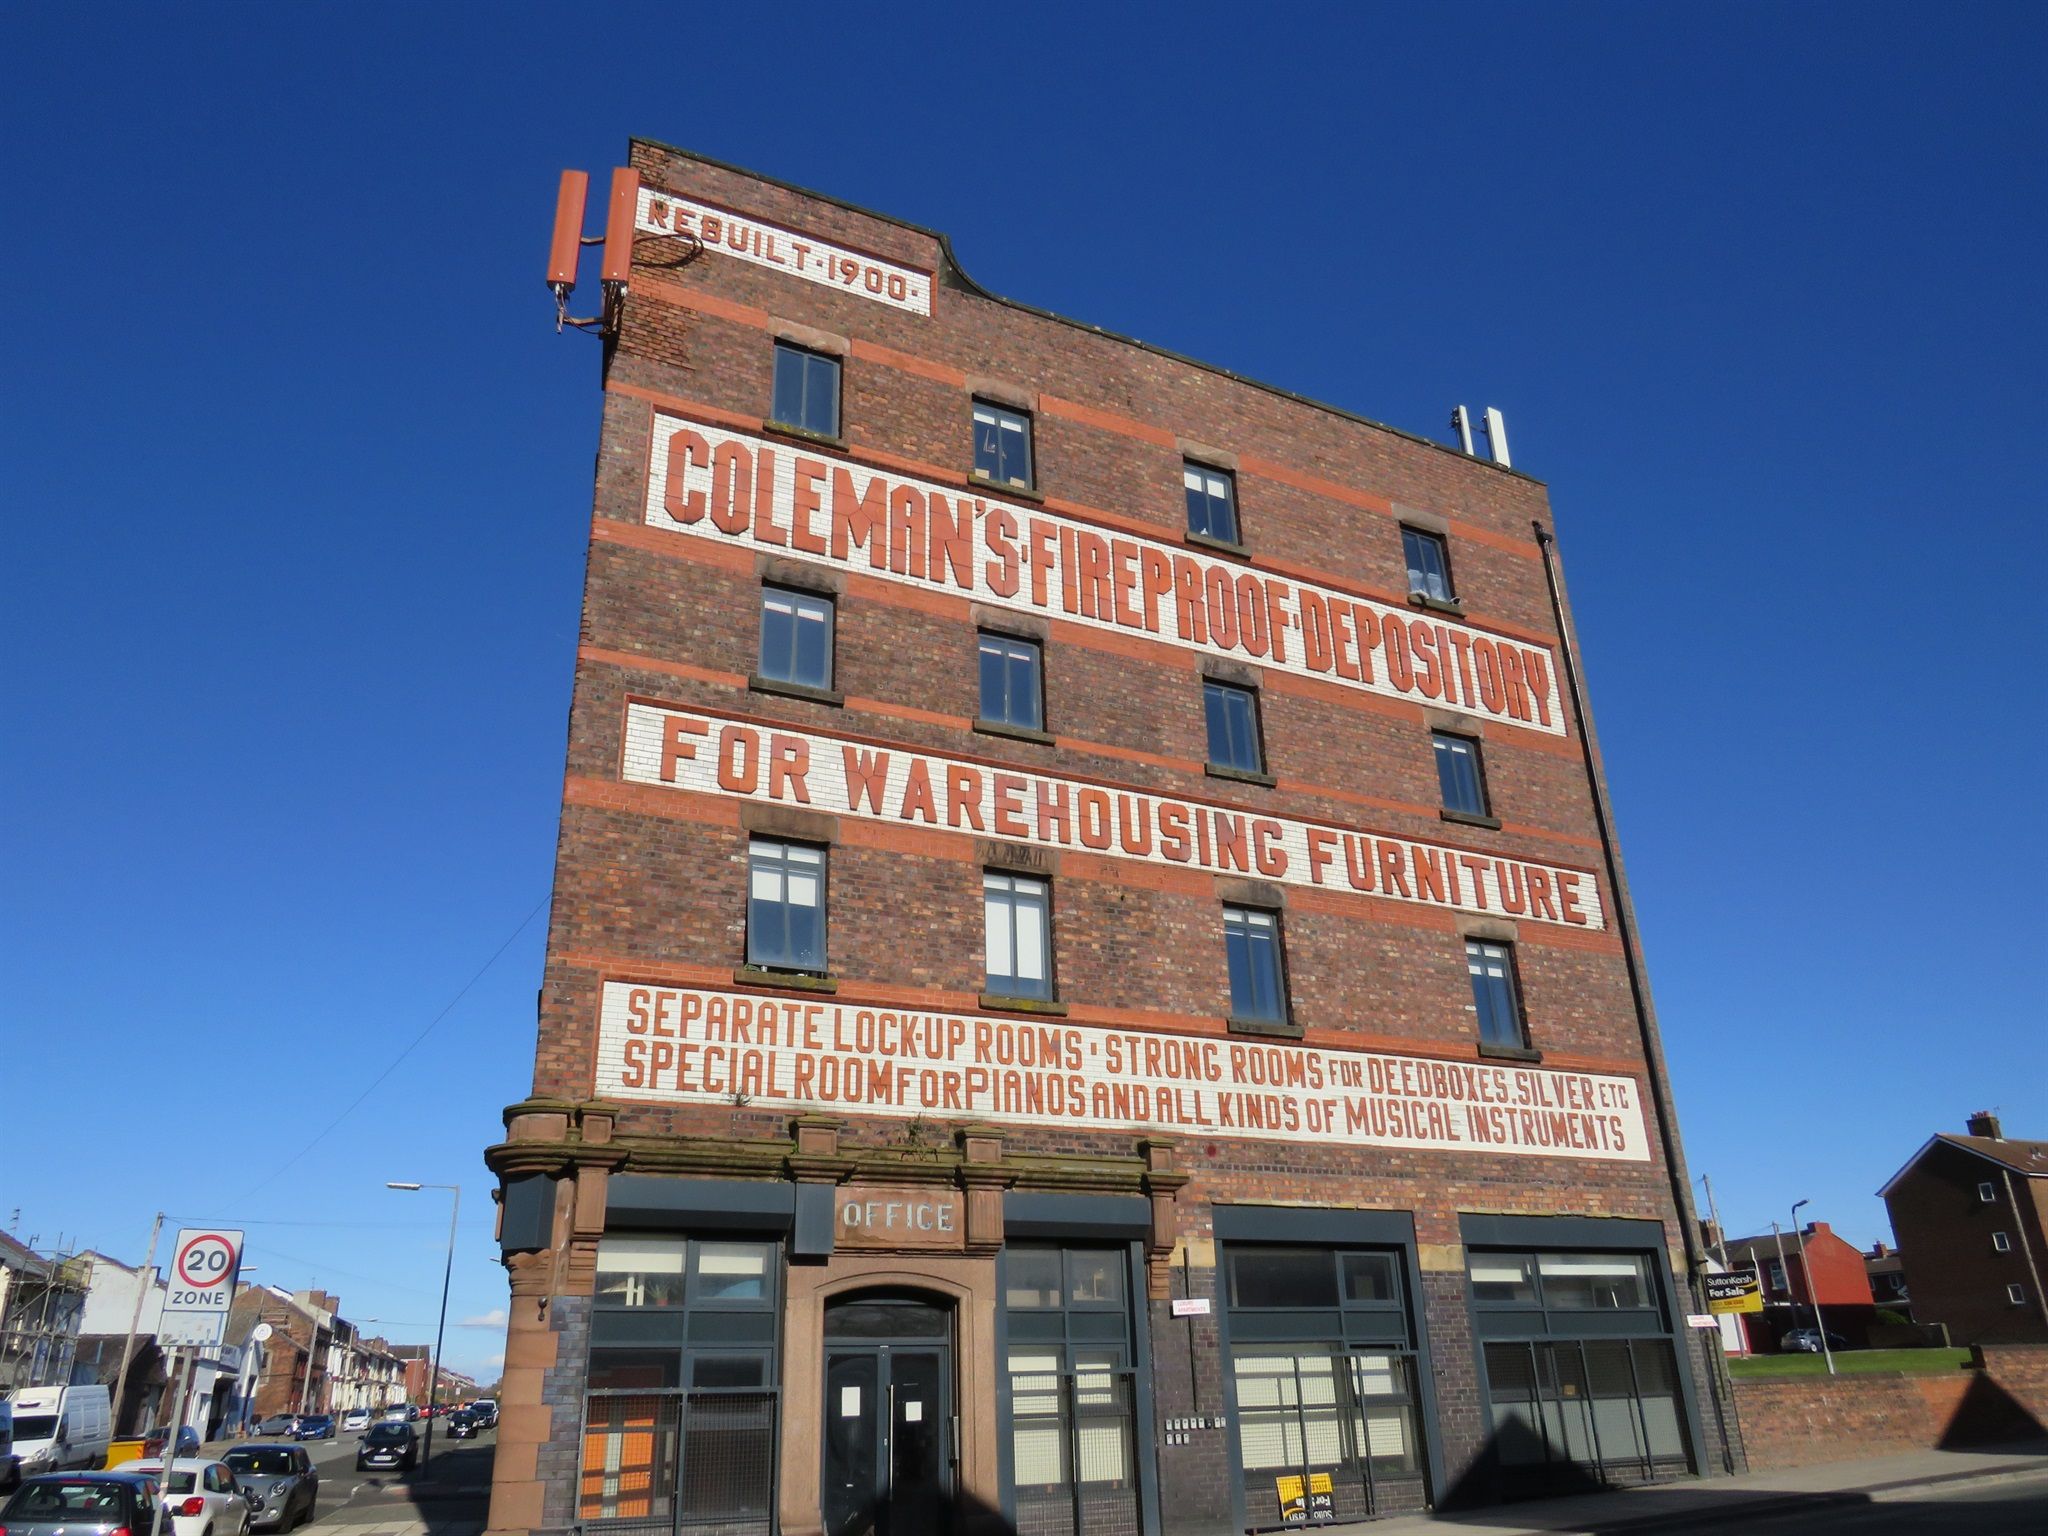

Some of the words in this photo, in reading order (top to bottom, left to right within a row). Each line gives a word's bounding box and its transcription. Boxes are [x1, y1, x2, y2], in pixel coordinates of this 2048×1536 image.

[648, 199, 811, 270] REBUILT
[664, 428, 1020, 598] COLEMAN'S
[1031, 517, 1289, 663] FIREPROOF
[1298, 588, 1552, 726] DEPOSITORY
[660, 715, 810, 804] FOR
[842, 745, 1288, 877] WAREHOUSING
[1306, 827, 1587, 925] FURNITURE
[626, 988, 825, 1050] SEPARATE
[974, 1021, 1082, 1071] ROOMS
[1105, 1034, 1222, 1082] STRONG
[1230, 1044, 1324, 1090] ROOMS
[1329, 1059, 1362, 1088] FOR
[1515, 1071, 1596, 1111] SILVER
[1599, 1083, 1629, 1109] ETC
[622, 1039, 787, 1098] SPECIAL
[795, 1053, 892, 1104] ROOM
[897, 1067, 961, 1110] FOR
[965, 1067, 1086, 1117] PIANOS
[1092, 1082, 1150, 1121] AND
[1157, 1086, 1212, 1125] ALL
[1217, 1092, 1300, 1131] KINDS
[1305, 1098, 1338, 1133] OF
[1344, 1096, 1460, 1141] MUSICAL
[1466, 1104, 1626, 1151] INSTRUMENTS
[843, 1201, 954, 1231] OFFICE
[187, 1249, 227, 1271] 20
[1707, 1275, 1752, 1286] SuttonKersh
[172, 1291, 225, 1305] ZONE
[1709, 1289, 1723, 1297] For
[1725, 1287, 1745, 1296] Sale
